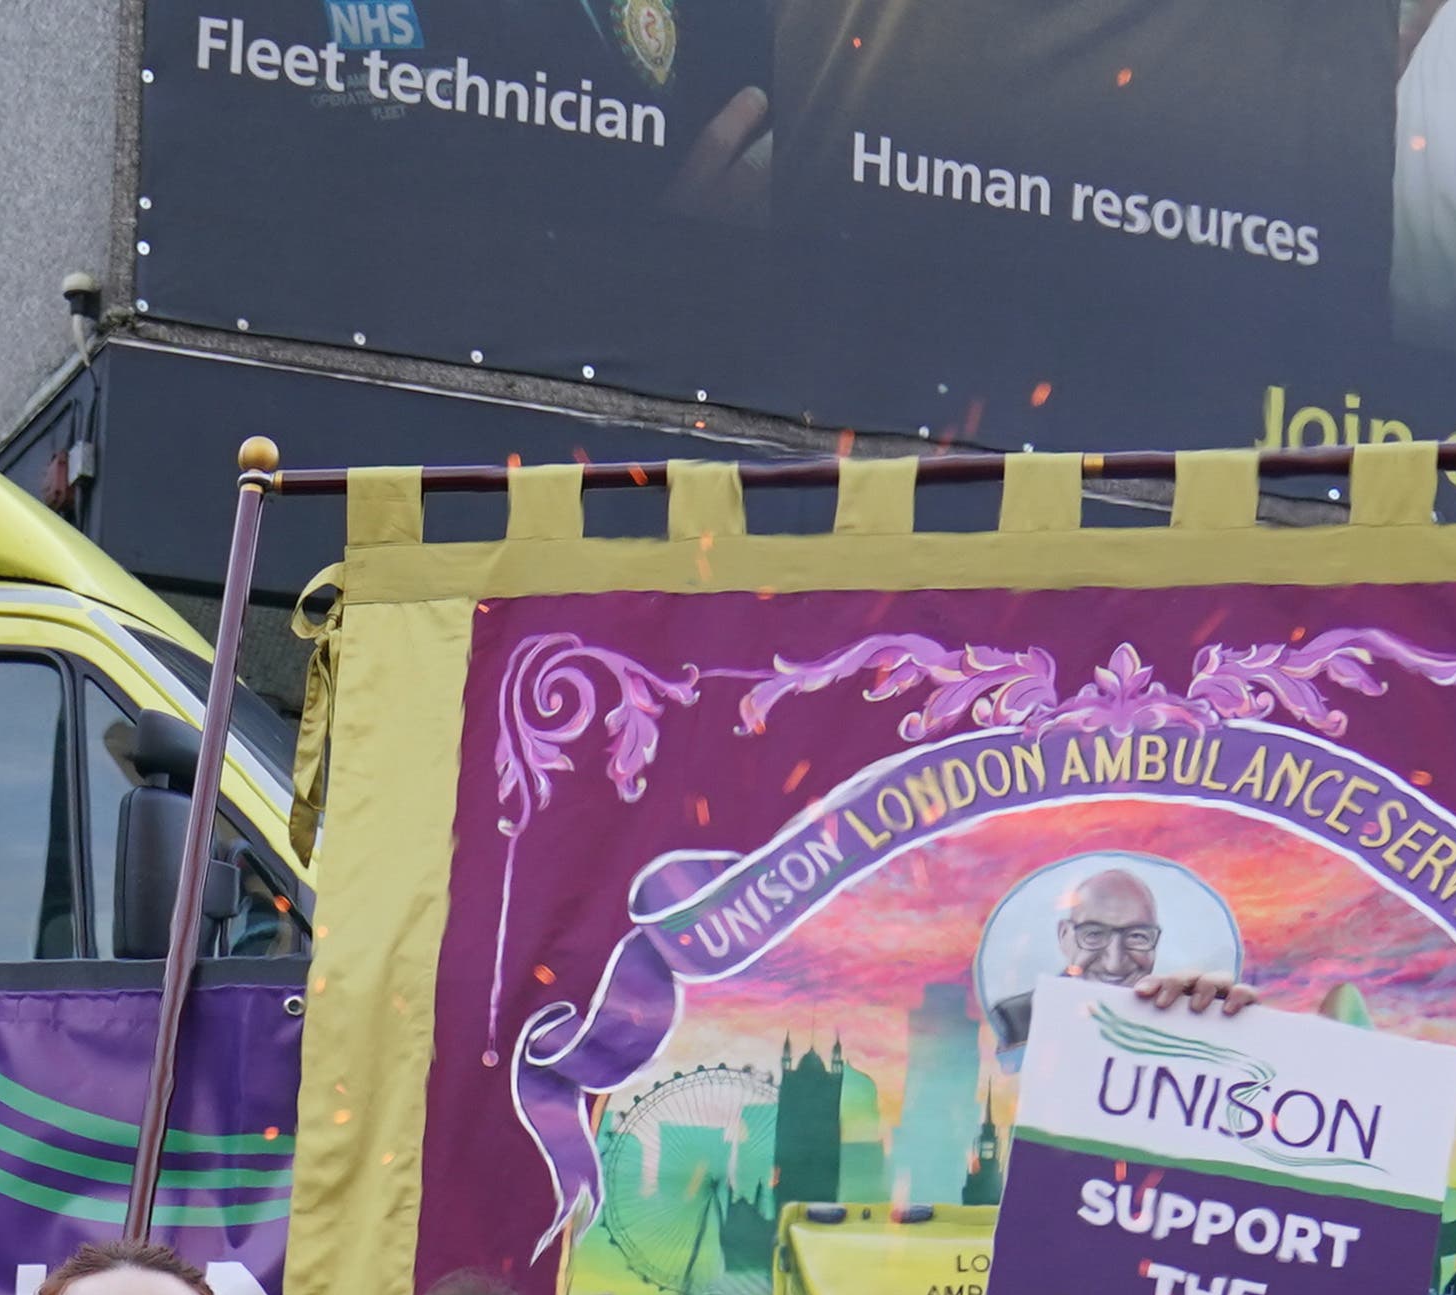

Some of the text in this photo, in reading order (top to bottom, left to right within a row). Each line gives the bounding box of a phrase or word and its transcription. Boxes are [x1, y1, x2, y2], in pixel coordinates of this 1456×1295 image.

[197, 16, 346, 93] Fleet
[363, 48, 667, 147] technician
[329, 3, 415, 45] NHS
[852, 131, 1320, 267] Human resources
[695, 829, 846, 958] UNISON
[845, 741, 1046, 850] LONDON
[1061, 735, 1379, 835] AMBULANCE
[1097, 1057, 1381, 1160] UNISON
[1077, 1179, 1360, 1268] SUPPORT
